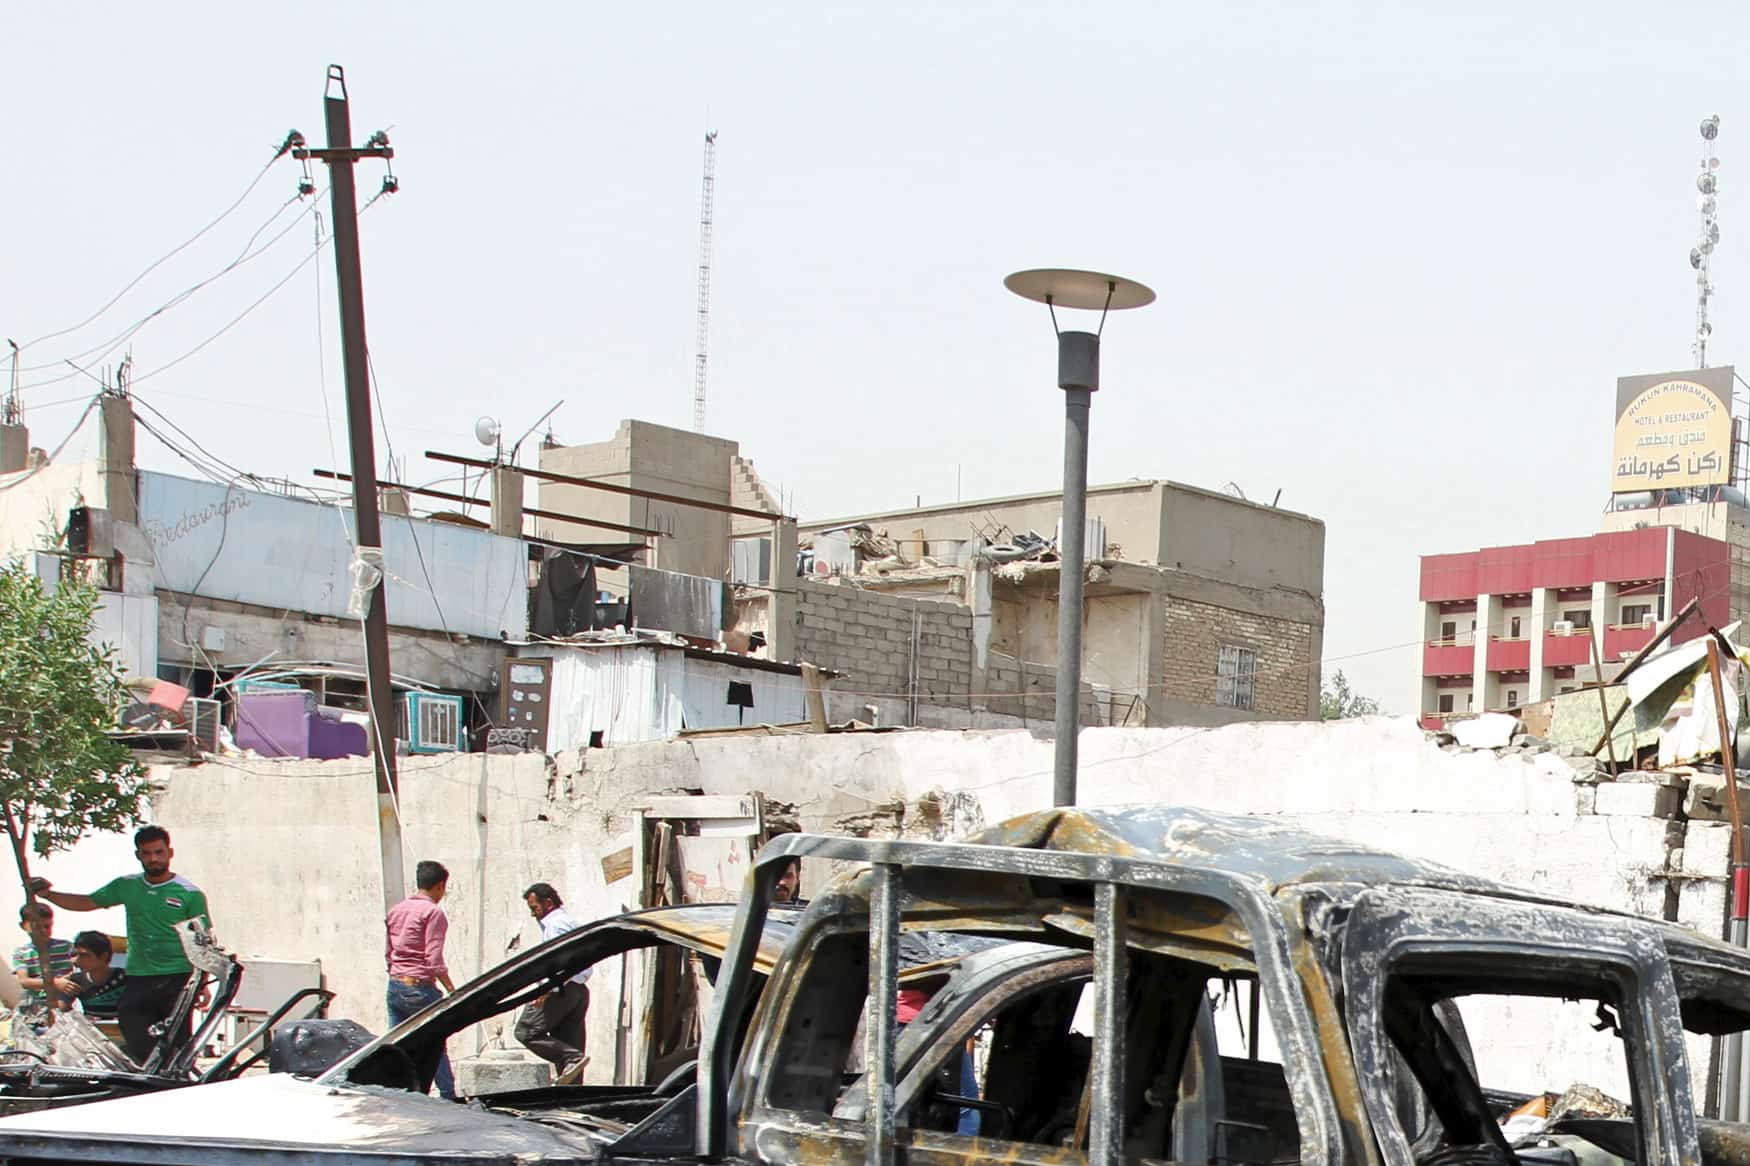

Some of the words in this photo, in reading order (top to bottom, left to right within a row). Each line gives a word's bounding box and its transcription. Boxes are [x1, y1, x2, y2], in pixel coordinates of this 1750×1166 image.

[1628, 389, 1661, 417] RUKUN
[1663, 383, 1718, 412] KAHRAMANA
[1635, 415, 1656, 425] HOTEL
[1665, 411, 1710, 424] RESTAURANT
[1617, 453, 1681, 480] كهرمانة
[1687, 450, 1722, 475] ركن
